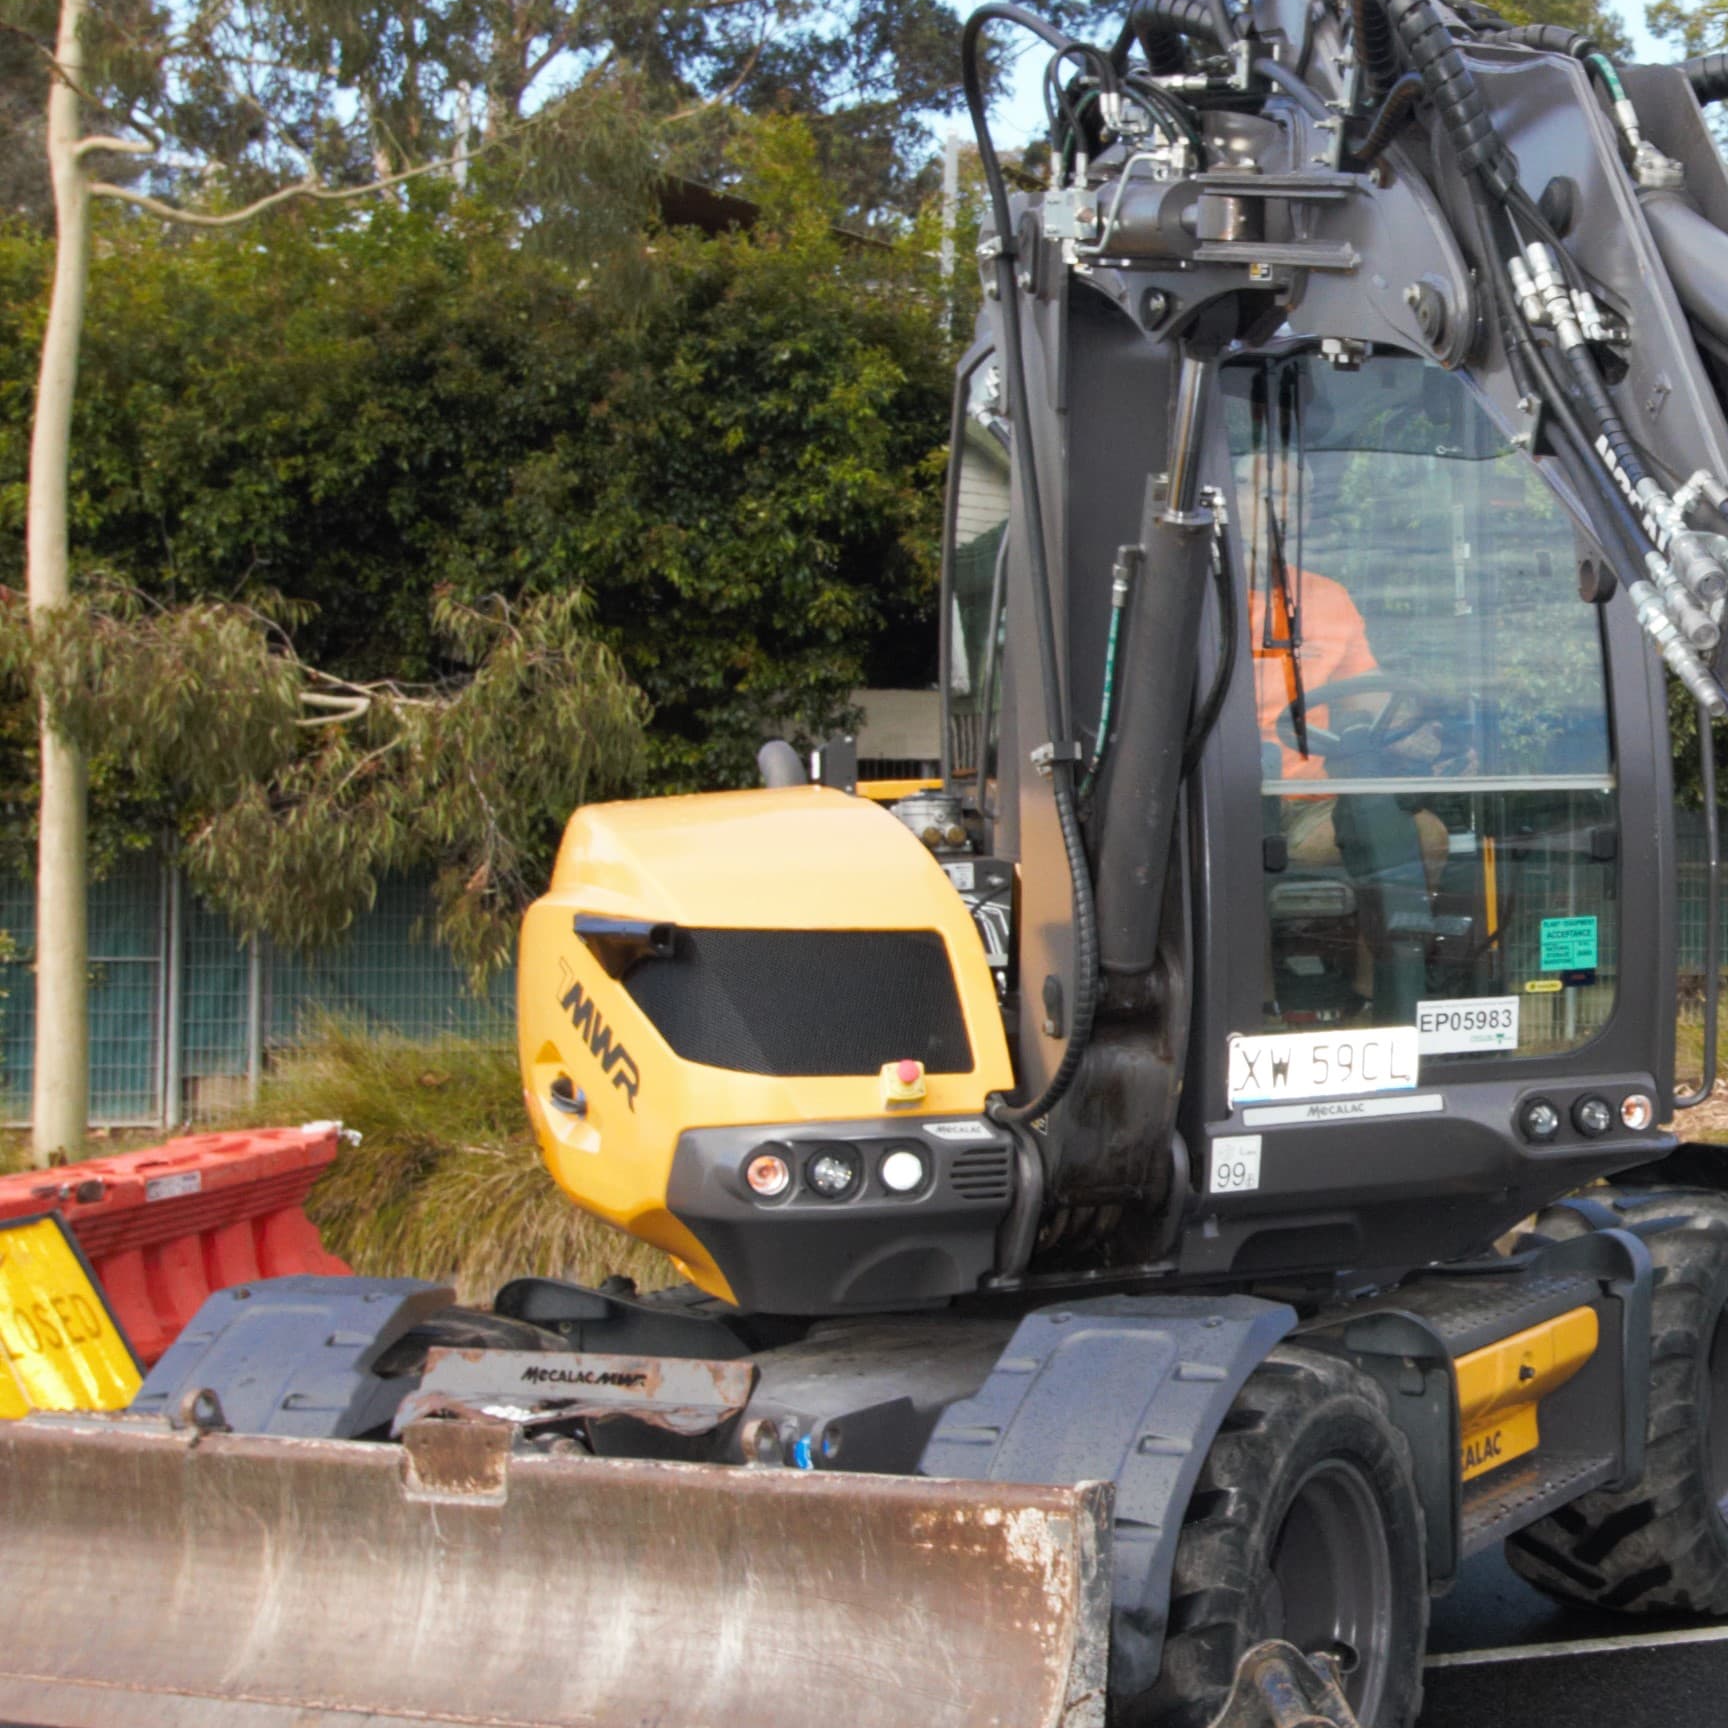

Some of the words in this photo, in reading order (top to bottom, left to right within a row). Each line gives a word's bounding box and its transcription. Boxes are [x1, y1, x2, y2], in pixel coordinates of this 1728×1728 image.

[1420, 1008, 1513, 1033] EP05983
[1216, 1161, 1247, 1188] 99
[0, 1293, 103, 1360] LOSED
[1463, 1429, 1503, 1472] ALAC
